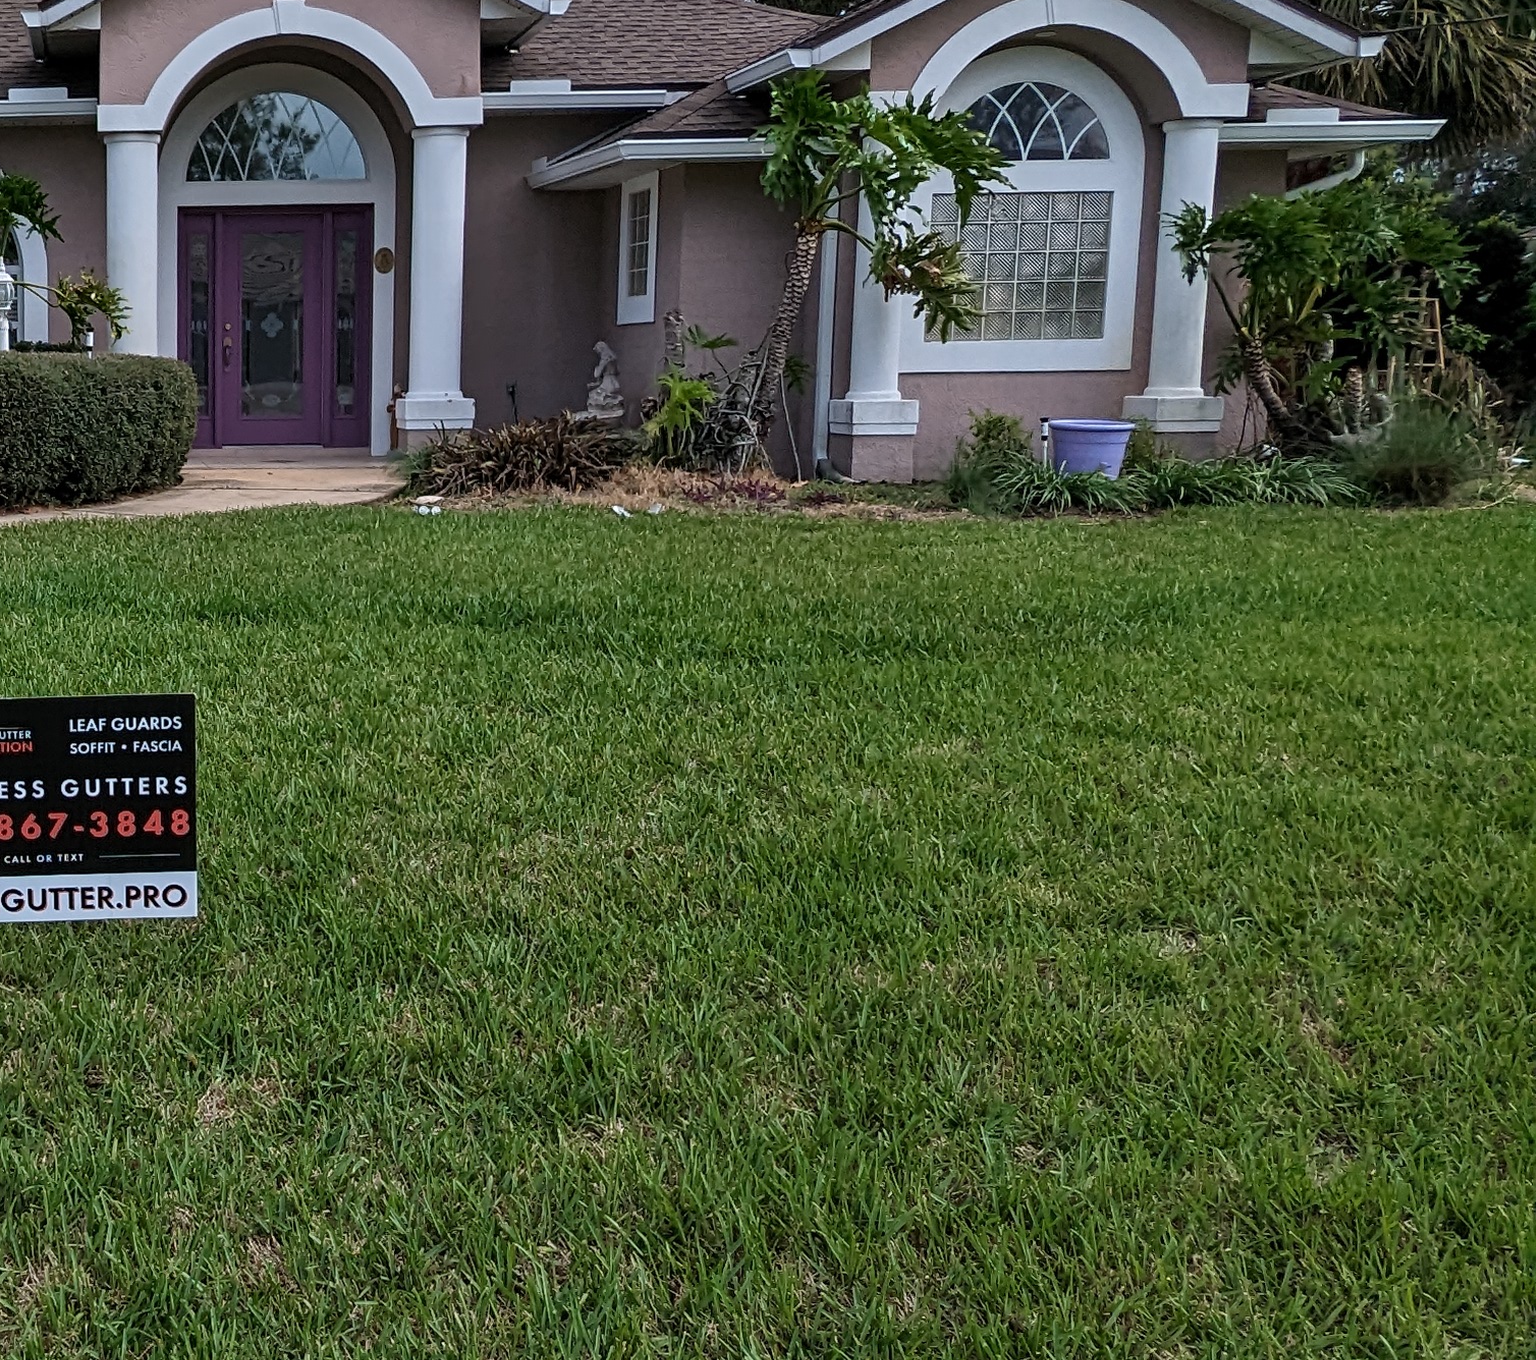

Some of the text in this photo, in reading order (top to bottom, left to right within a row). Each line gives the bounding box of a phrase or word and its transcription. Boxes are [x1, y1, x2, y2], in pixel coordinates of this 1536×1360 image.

[69, 715, 183, 732] LEAF GUARDS
[69, 740, 183, 755] SOFFIT FASCIA
[60, 775, 188, 798] GUTTERS
[3, 853, 84, 864] CALL OR TEXT
